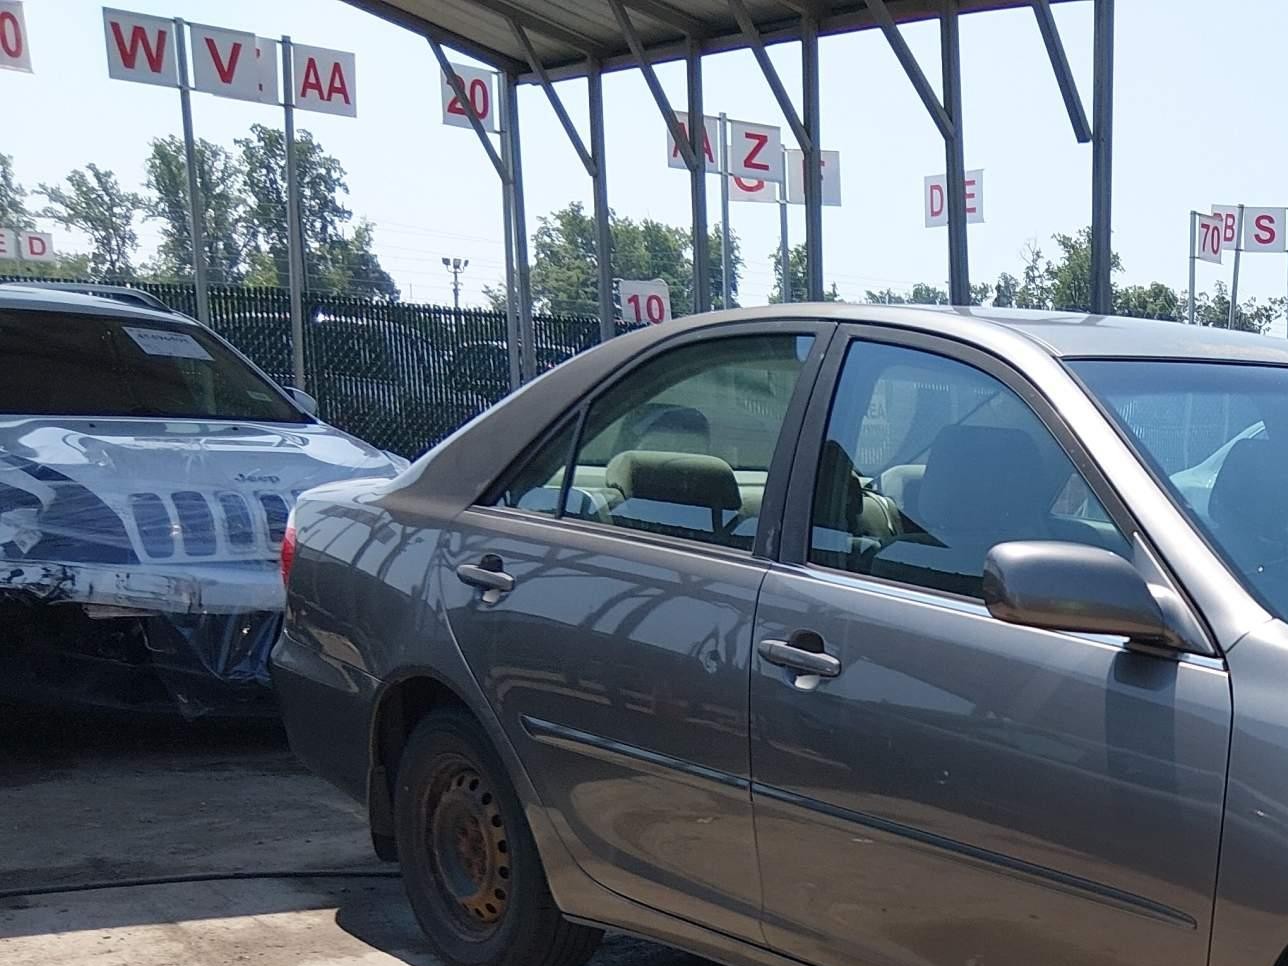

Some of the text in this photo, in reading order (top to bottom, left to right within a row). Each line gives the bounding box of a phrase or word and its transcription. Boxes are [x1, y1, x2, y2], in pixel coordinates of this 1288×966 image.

[110, 21, 167, 74] W
[203, 37, 242, 85] V
[300, 57, 352, 106] AA
[446, 74, 489, 120] 20
[743, 131, 770, 172] Z
[929, 184, 945, 217] D
[28, 236, 46, 256] D
[1200, 223, 1221, 255] 70
[1254, 214, 1276, 245] S
[627, 294, 665, 324] 10
